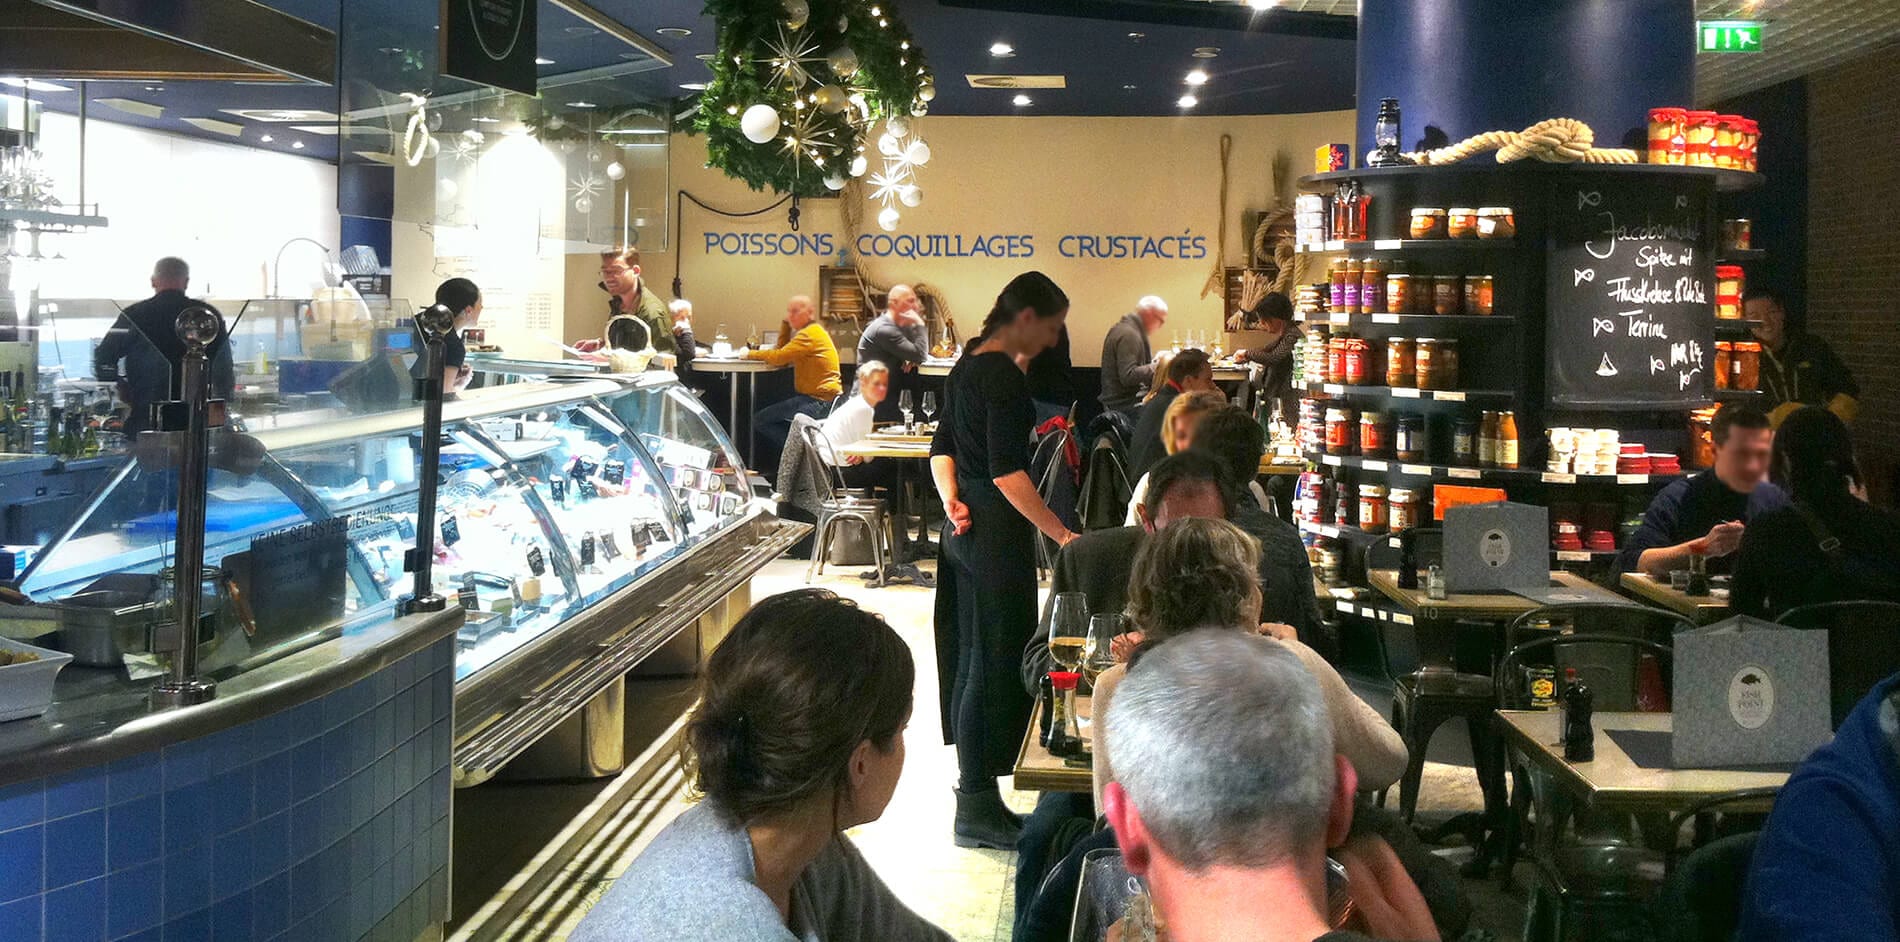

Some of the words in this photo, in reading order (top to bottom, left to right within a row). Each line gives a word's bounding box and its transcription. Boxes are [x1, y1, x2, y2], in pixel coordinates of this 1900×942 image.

[703, 232, 834, 256] POISSONS
[855, 233, 1034, 260] COQUILLAGES
[1057, 227, 1207, 259] CRUSTACÉS
[1617, 309, 1668, 339] Terrine
[250, 527, 288, 551] KEINE
[1423, 607, 1439, 620] 10
